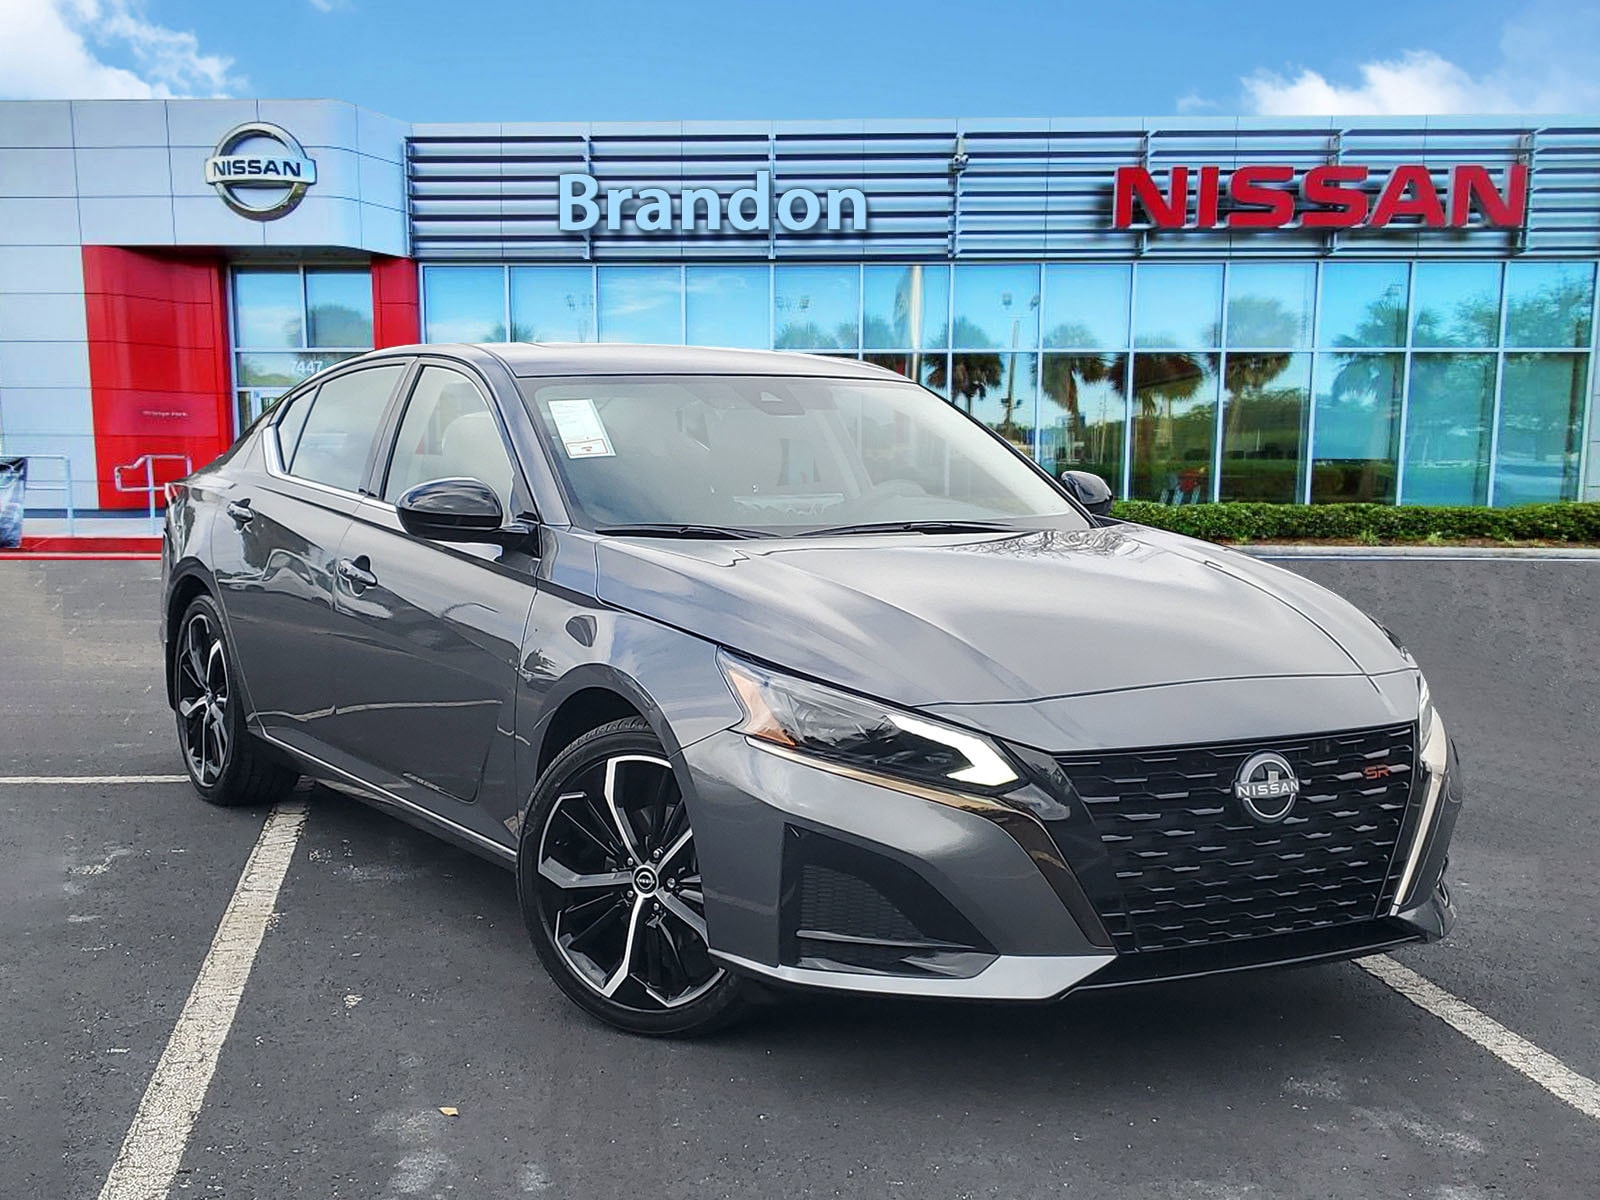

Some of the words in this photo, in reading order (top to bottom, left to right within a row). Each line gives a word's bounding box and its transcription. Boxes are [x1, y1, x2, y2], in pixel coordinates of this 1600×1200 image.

[213, 159, 301, 177] NISSAN
[559, 170, 867, 231] Brandon
[1112, 165, 1528, 229] NISSAN
[1364, 764, 1390, 780] SR
[1237, 780, 1299, 797] NISSAN
